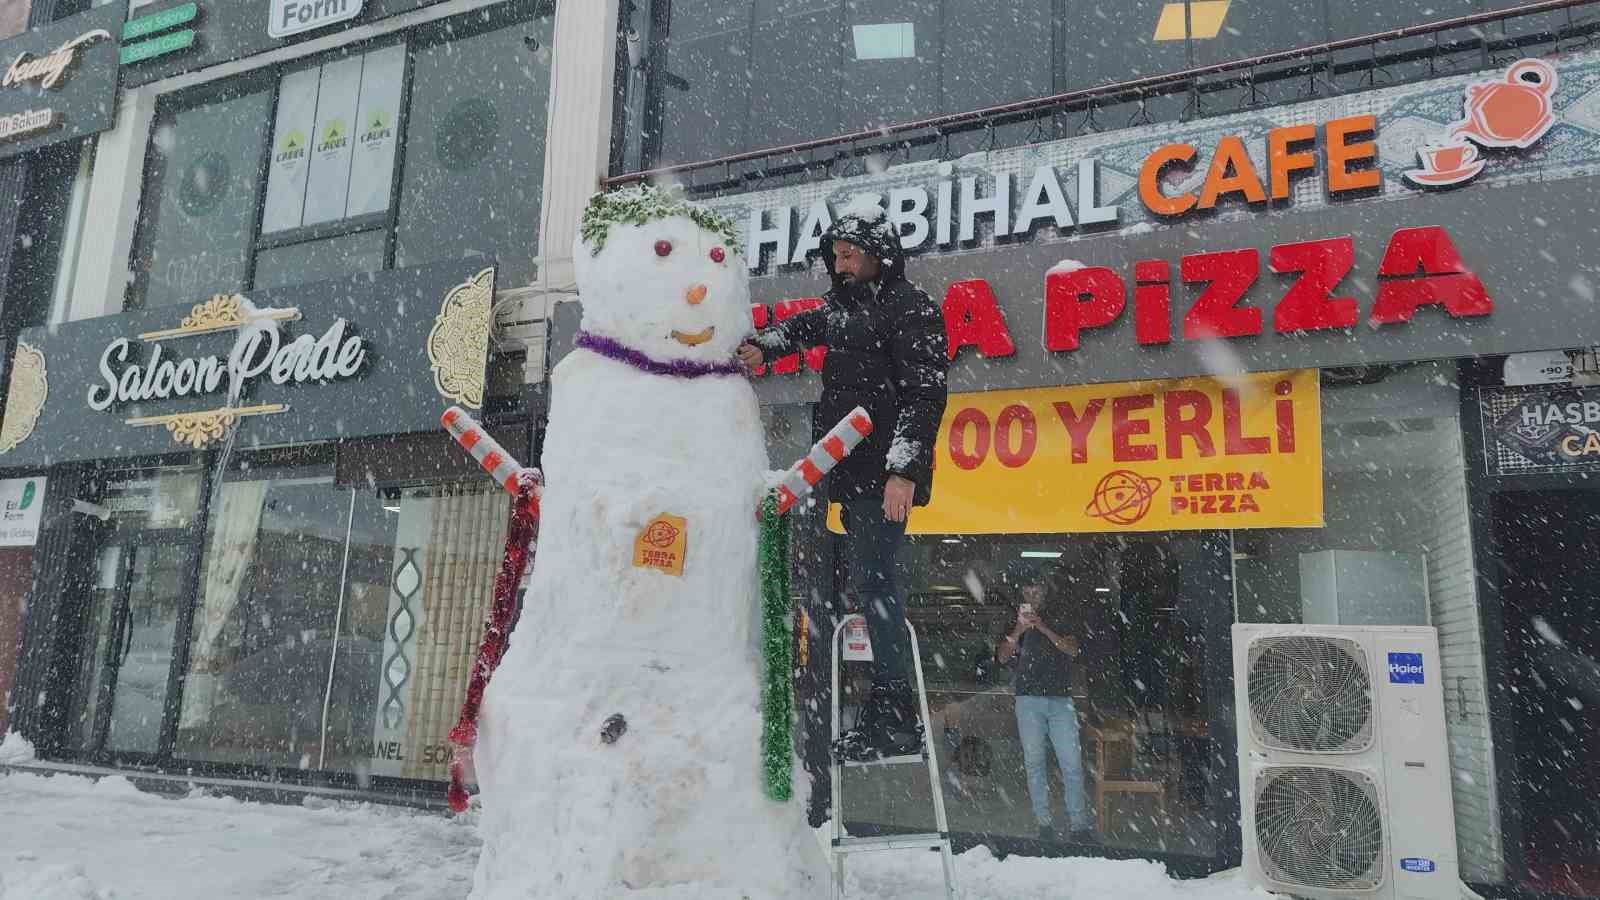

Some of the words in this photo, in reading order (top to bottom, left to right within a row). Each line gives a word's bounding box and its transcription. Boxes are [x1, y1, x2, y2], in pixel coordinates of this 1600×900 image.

[282, 0, 347, 28] Form
[1138, 115, 1382, 215] CAFE
[88, 337, 229, 411] Saloon
[1169, 472, 1269, 493] TERRA
[1390, 663, 1424, 674] Haier
